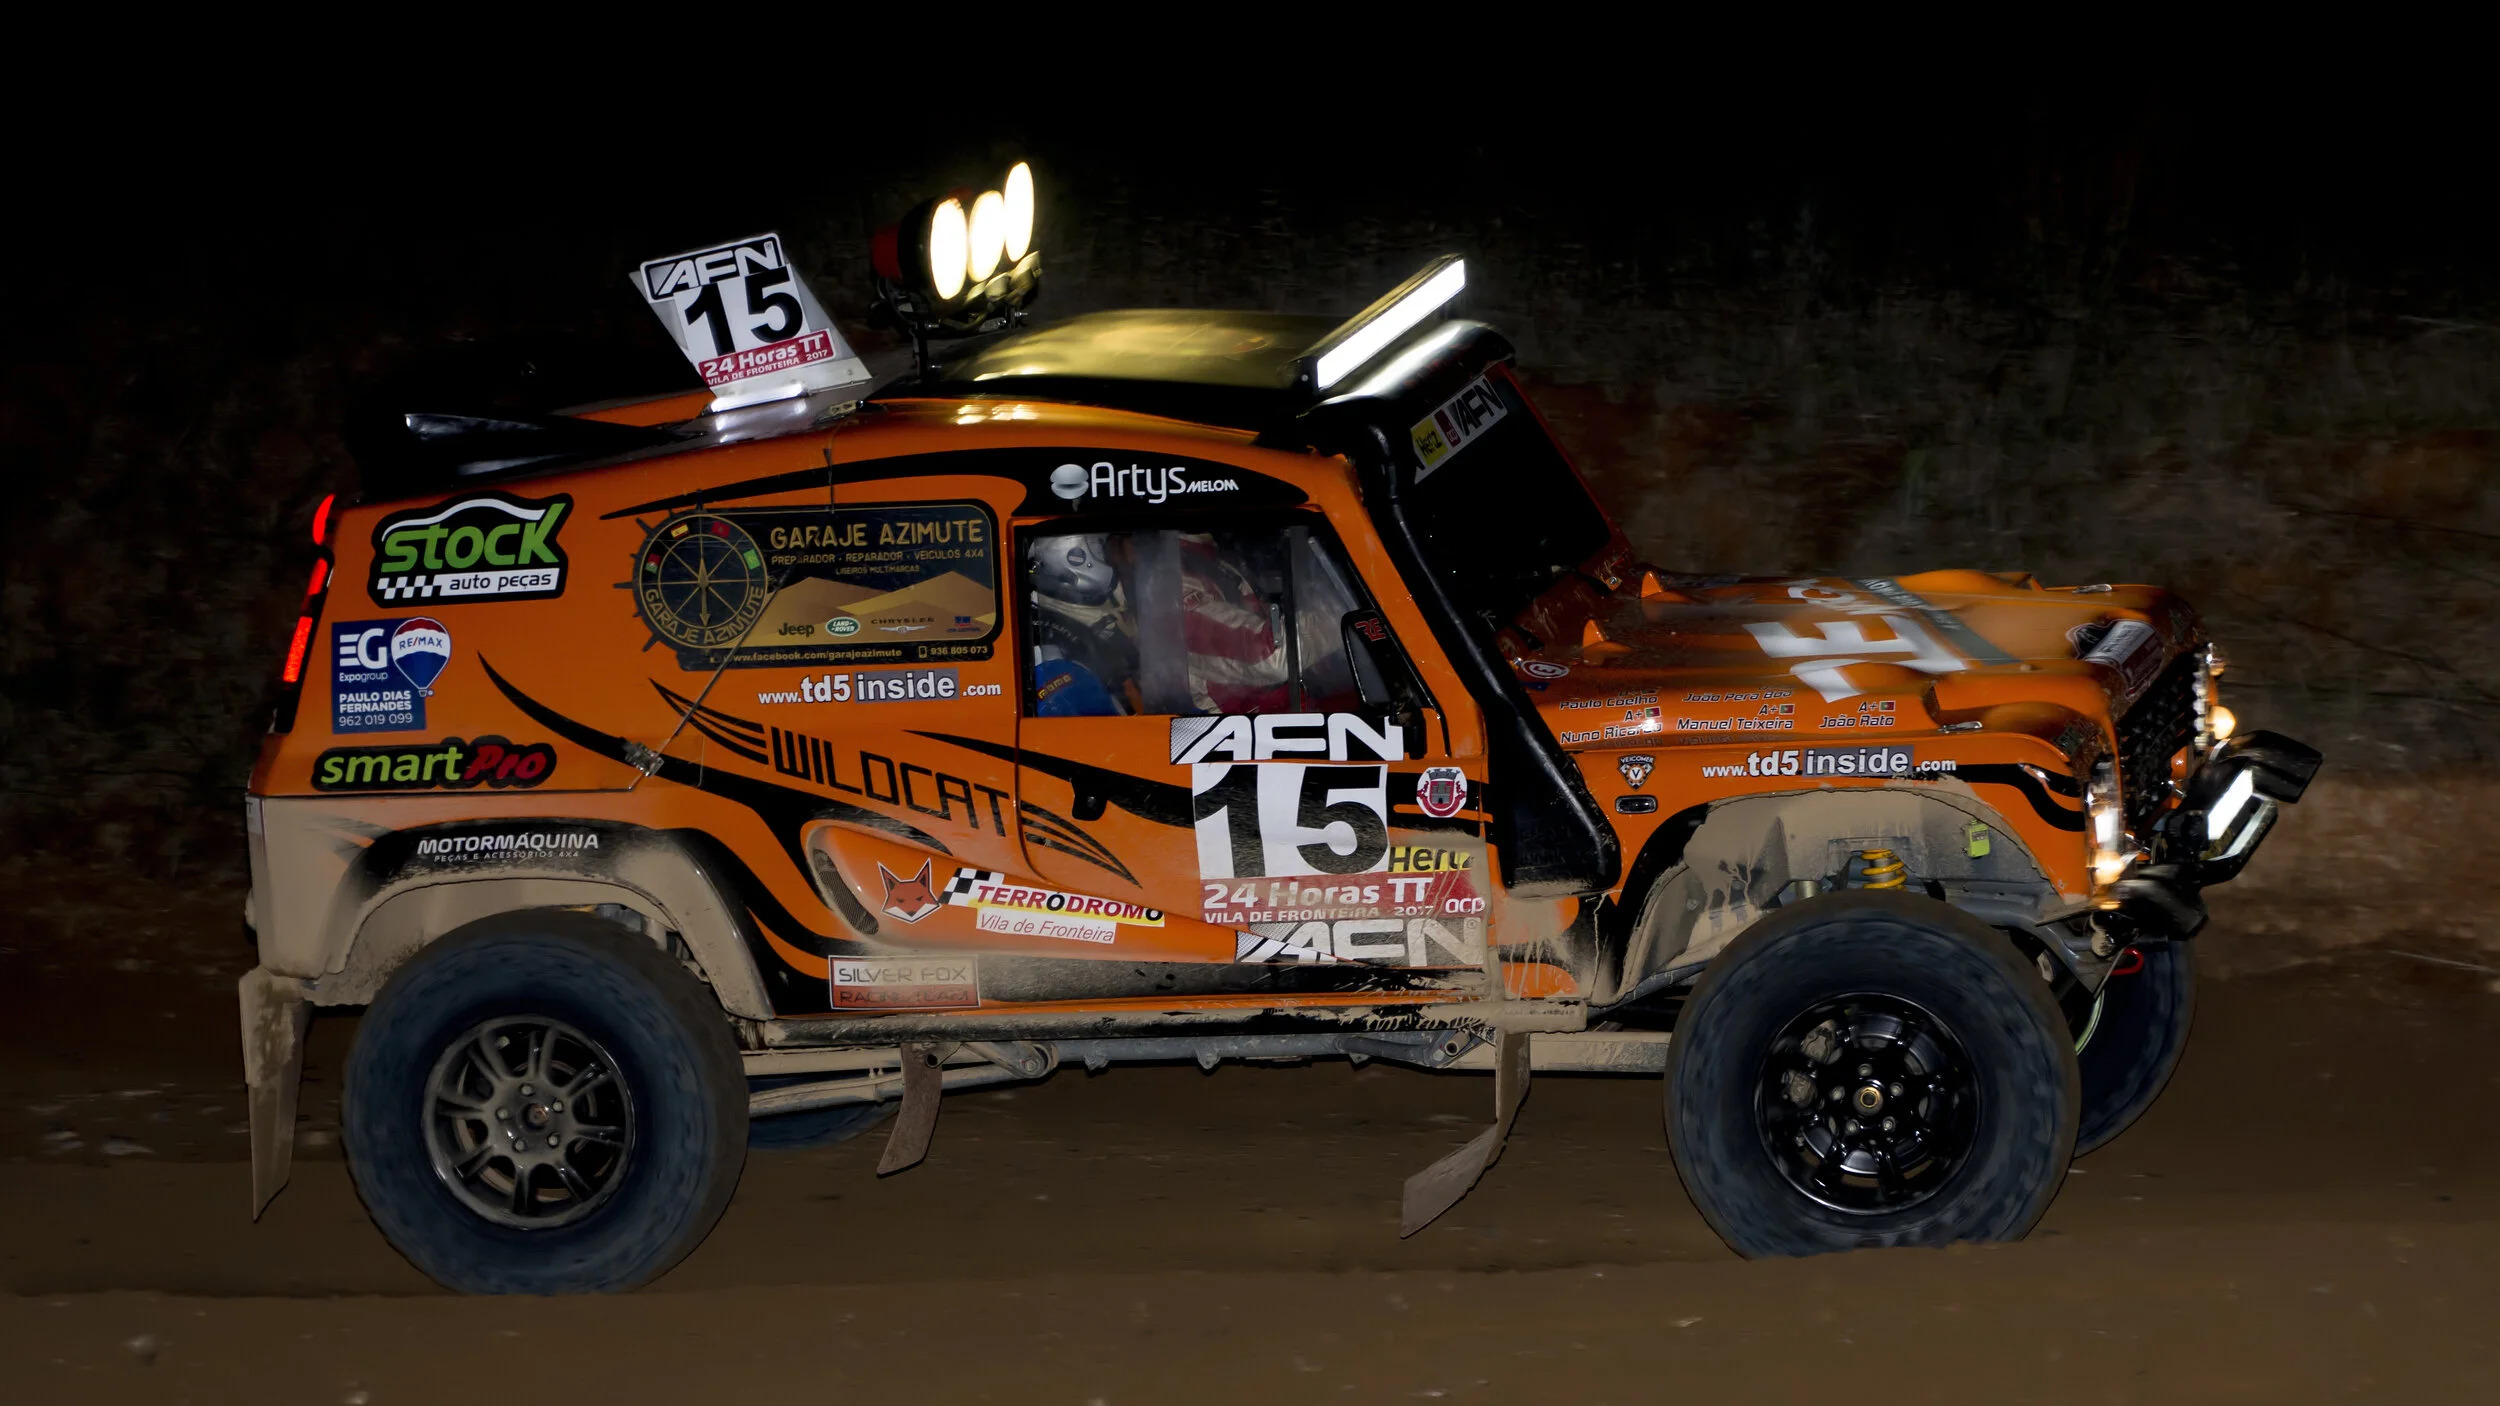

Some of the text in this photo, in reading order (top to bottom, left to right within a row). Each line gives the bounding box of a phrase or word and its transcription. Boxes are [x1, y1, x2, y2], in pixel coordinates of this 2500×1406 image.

[657, 241, 782, 295] AFN
[685, 266, 803, 356] 15
[704, 334, 823, 378] 24 Horas TT
[806, 349, 828, 361] 2017
[707, 358, 800, 386] VILA DE FRONTEIRA
[1186, 478, 1239, 493] MELOM
[770, 519, 984, 550] GARAJE AZIMUTE
[846, 551, 903, 563] REPARADOR
[449, 572, 551, 591] auto peças
[645, 586, 764, 645] GARAJE AZIMUTE
[778, 622, 815, 638] Jeep
[339, 628, 388, 669] EG
[399, 636, 443, 650] RE/MAX
[930, 647, 949, 656] 936
[970, 645, 988, 655] 073
[339, 671, 388, 683] Expogroup
[339, 690, 412, 703] PAULO DIAS
[1560, 695, 1658, 710] Paulo Coelho
[340, 701, 412, 713] FERNANDES
[1759, 704, 1779, 715] A+
[1859, 701, 1879, 712] A+
[339, 713, 412, 727] 962 019 099
[1624, 710, 1643, 721] A+
[1677, 716, 1793, 730] Manuel Teixeira
[1819, 714, 1895, 728] João Rato
[1177, 712, 1404, 762] AFN
[1560, 722, 1662, 744] Nuno Ricaro
[771, 727, 1009, 837] WILDCAT
[1194, 764, 1388, 878] 15
[417, 832, 599, 854] MOTORMÁQUINA
[1204, 877, 1434, 909] 24 Horas TT
[1205, 905, 1434, 924] VILA DE FRONTEIRA 2017
[981, 912, 1114, 942] Vila de Fronteira
[839, 966, 968, 983] SILVER FOX
